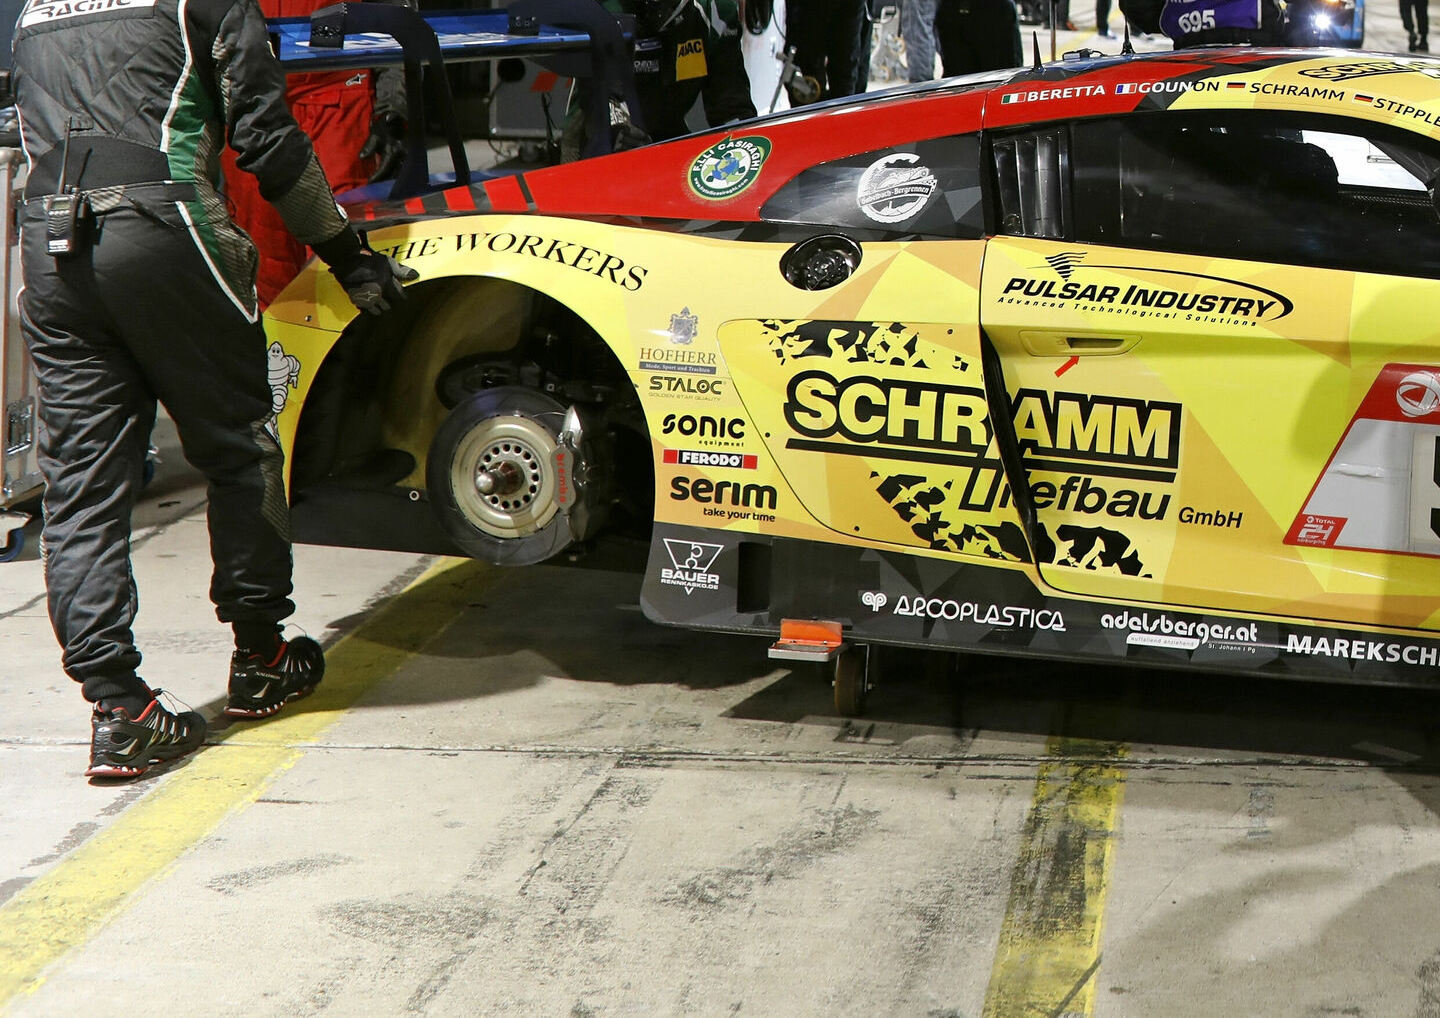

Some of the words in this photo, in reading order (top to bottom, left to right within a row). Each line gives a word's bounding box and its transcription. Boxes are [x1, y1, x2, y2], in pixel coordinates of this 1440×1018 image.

[1178, 9, 1216, 34] 695
[1027, 85, 1106, 102] BERETTA
[1138, 81, 1220, 94] GOUNON
[1249, 82, 1345, 102] SCHRAMM
[718, 140, 759, 172] CASIRAGHI
[455, 232, 649, 292] WORKERS
[1003, 277, 1122, 304] PULSAR
[1122, 285, 1277, 318] INDUSTRY
[997, 296, 1065, 310] Advanced
[1074, 303, 1177, 320] Technological
[1185, 313, 1257, 328] Solutions
[640, 347, 717, 365] HOFHERR
[663, 364, 677, 372] Sport
[650, 375, 722, 395] STALOC
[662, 413, 745, 440] sonic
[788, 372, 1179, 466] SCHRAMM
[698, 440, 744, 448] equipment
[681, 451, 741, 467] FERODO
[670, 476, 778, 510] serim
[703, 507, 726, 517] take
[727, 509, 751, 520] your
[752, 511, 776, 522] time
[1178, 506, 1244, 530] GmbH
[1315, 517, 1336, 525] TOTAL
[1298, 523, 1334, 541] 24
[661, 568, 720, 585] BAUER
[661, 578, 719, 590] RENNKASKO.DE
[893, 595, 1067, 632] ARCOPLASTICA
[1100, 611, 1258, 644] adelsberger.at
[1219, 644, 1242, 652] Johann
